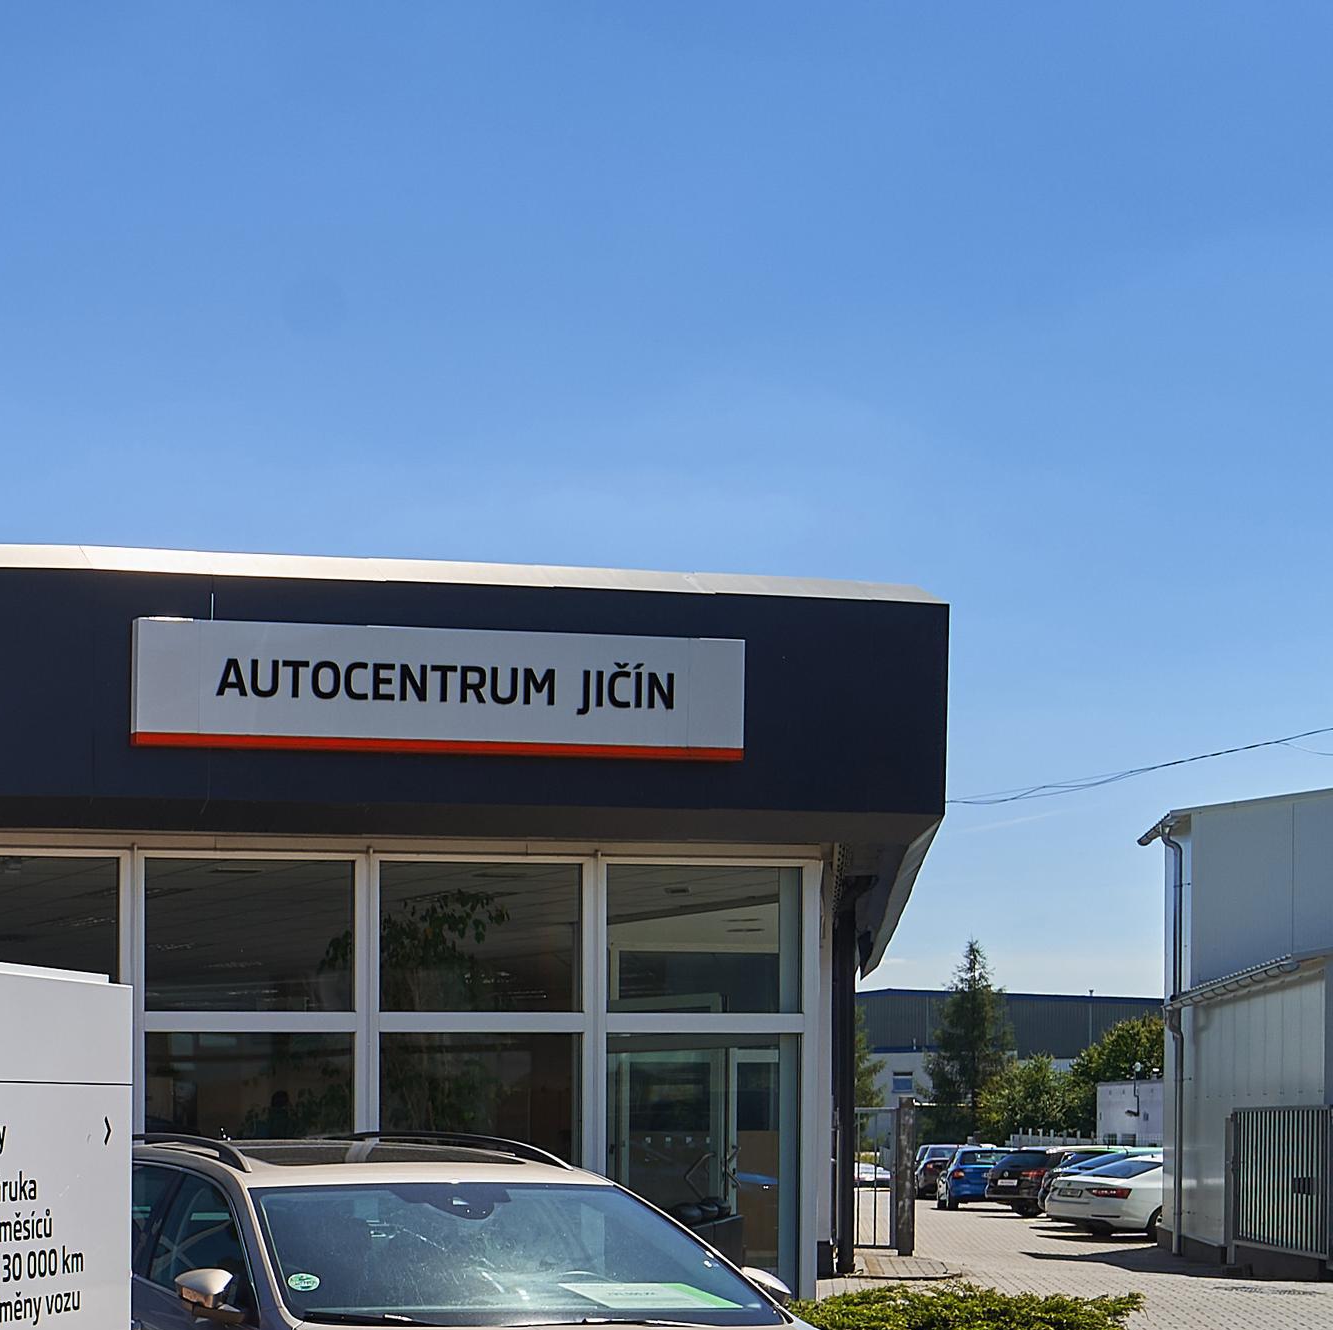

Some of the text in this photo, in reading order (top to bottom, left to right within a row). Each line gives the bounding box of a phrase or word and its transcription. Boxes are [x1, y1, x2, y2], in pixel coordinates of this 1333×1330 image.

[215, 658, 675, 716] AUTOCENTRUM JIČÍN
[2, 1252, 22, 1283] 30
[27, 1248, 58, 1280] 000
[62, 1245, 84, 1275] km
[45, 1290, 81, 1315] vozu
